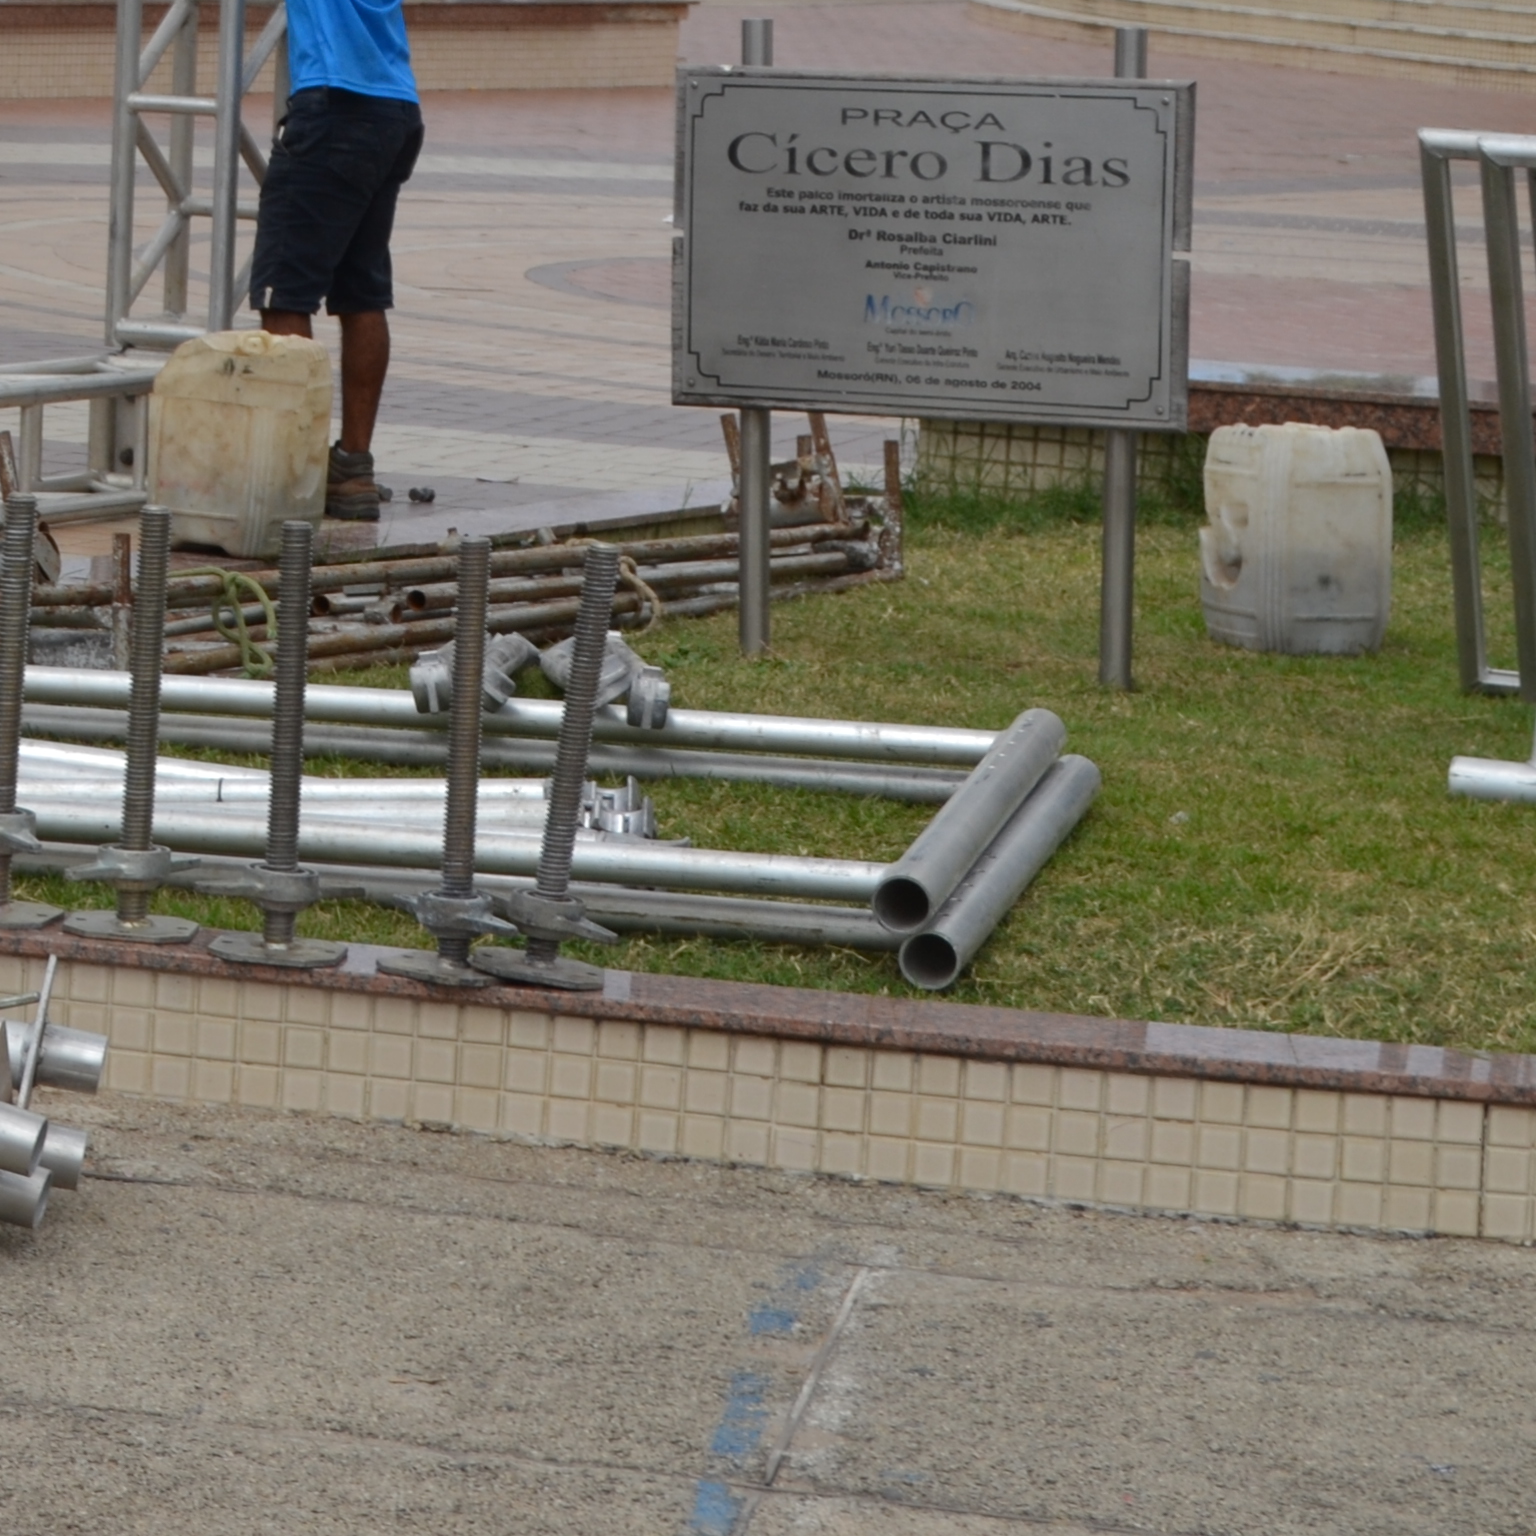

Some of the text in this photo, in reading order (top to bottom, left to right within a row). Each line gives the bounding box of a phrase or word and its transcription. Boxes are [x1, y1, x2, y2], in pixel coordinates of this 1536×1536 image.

[840, 107, 1006, 134] PRAÇA
[727, 131, 1131, 188] Cícero Dias
[766, 188, 1093, 213] Este palco imortaliza o artista mossoroense que
[739, 201, 1073, 226] faz da sua ARTE, VIDA e de toda sua VIDA, ARTE.
[876, 230, 938, 244] Rosalba
[942, 233, 998, 247] Ciarlini
[900, 244, 944, 256] Prefeita
[865, 260, 978, 274] Antonio Capistrano
[905, 375, 922, 384] 06
[924, 375, 940, 385] de
[944, 378, 988, 388] agosto
[990, 379, 1008, 389] de
[1010, 380, 1042, 391] 2004
